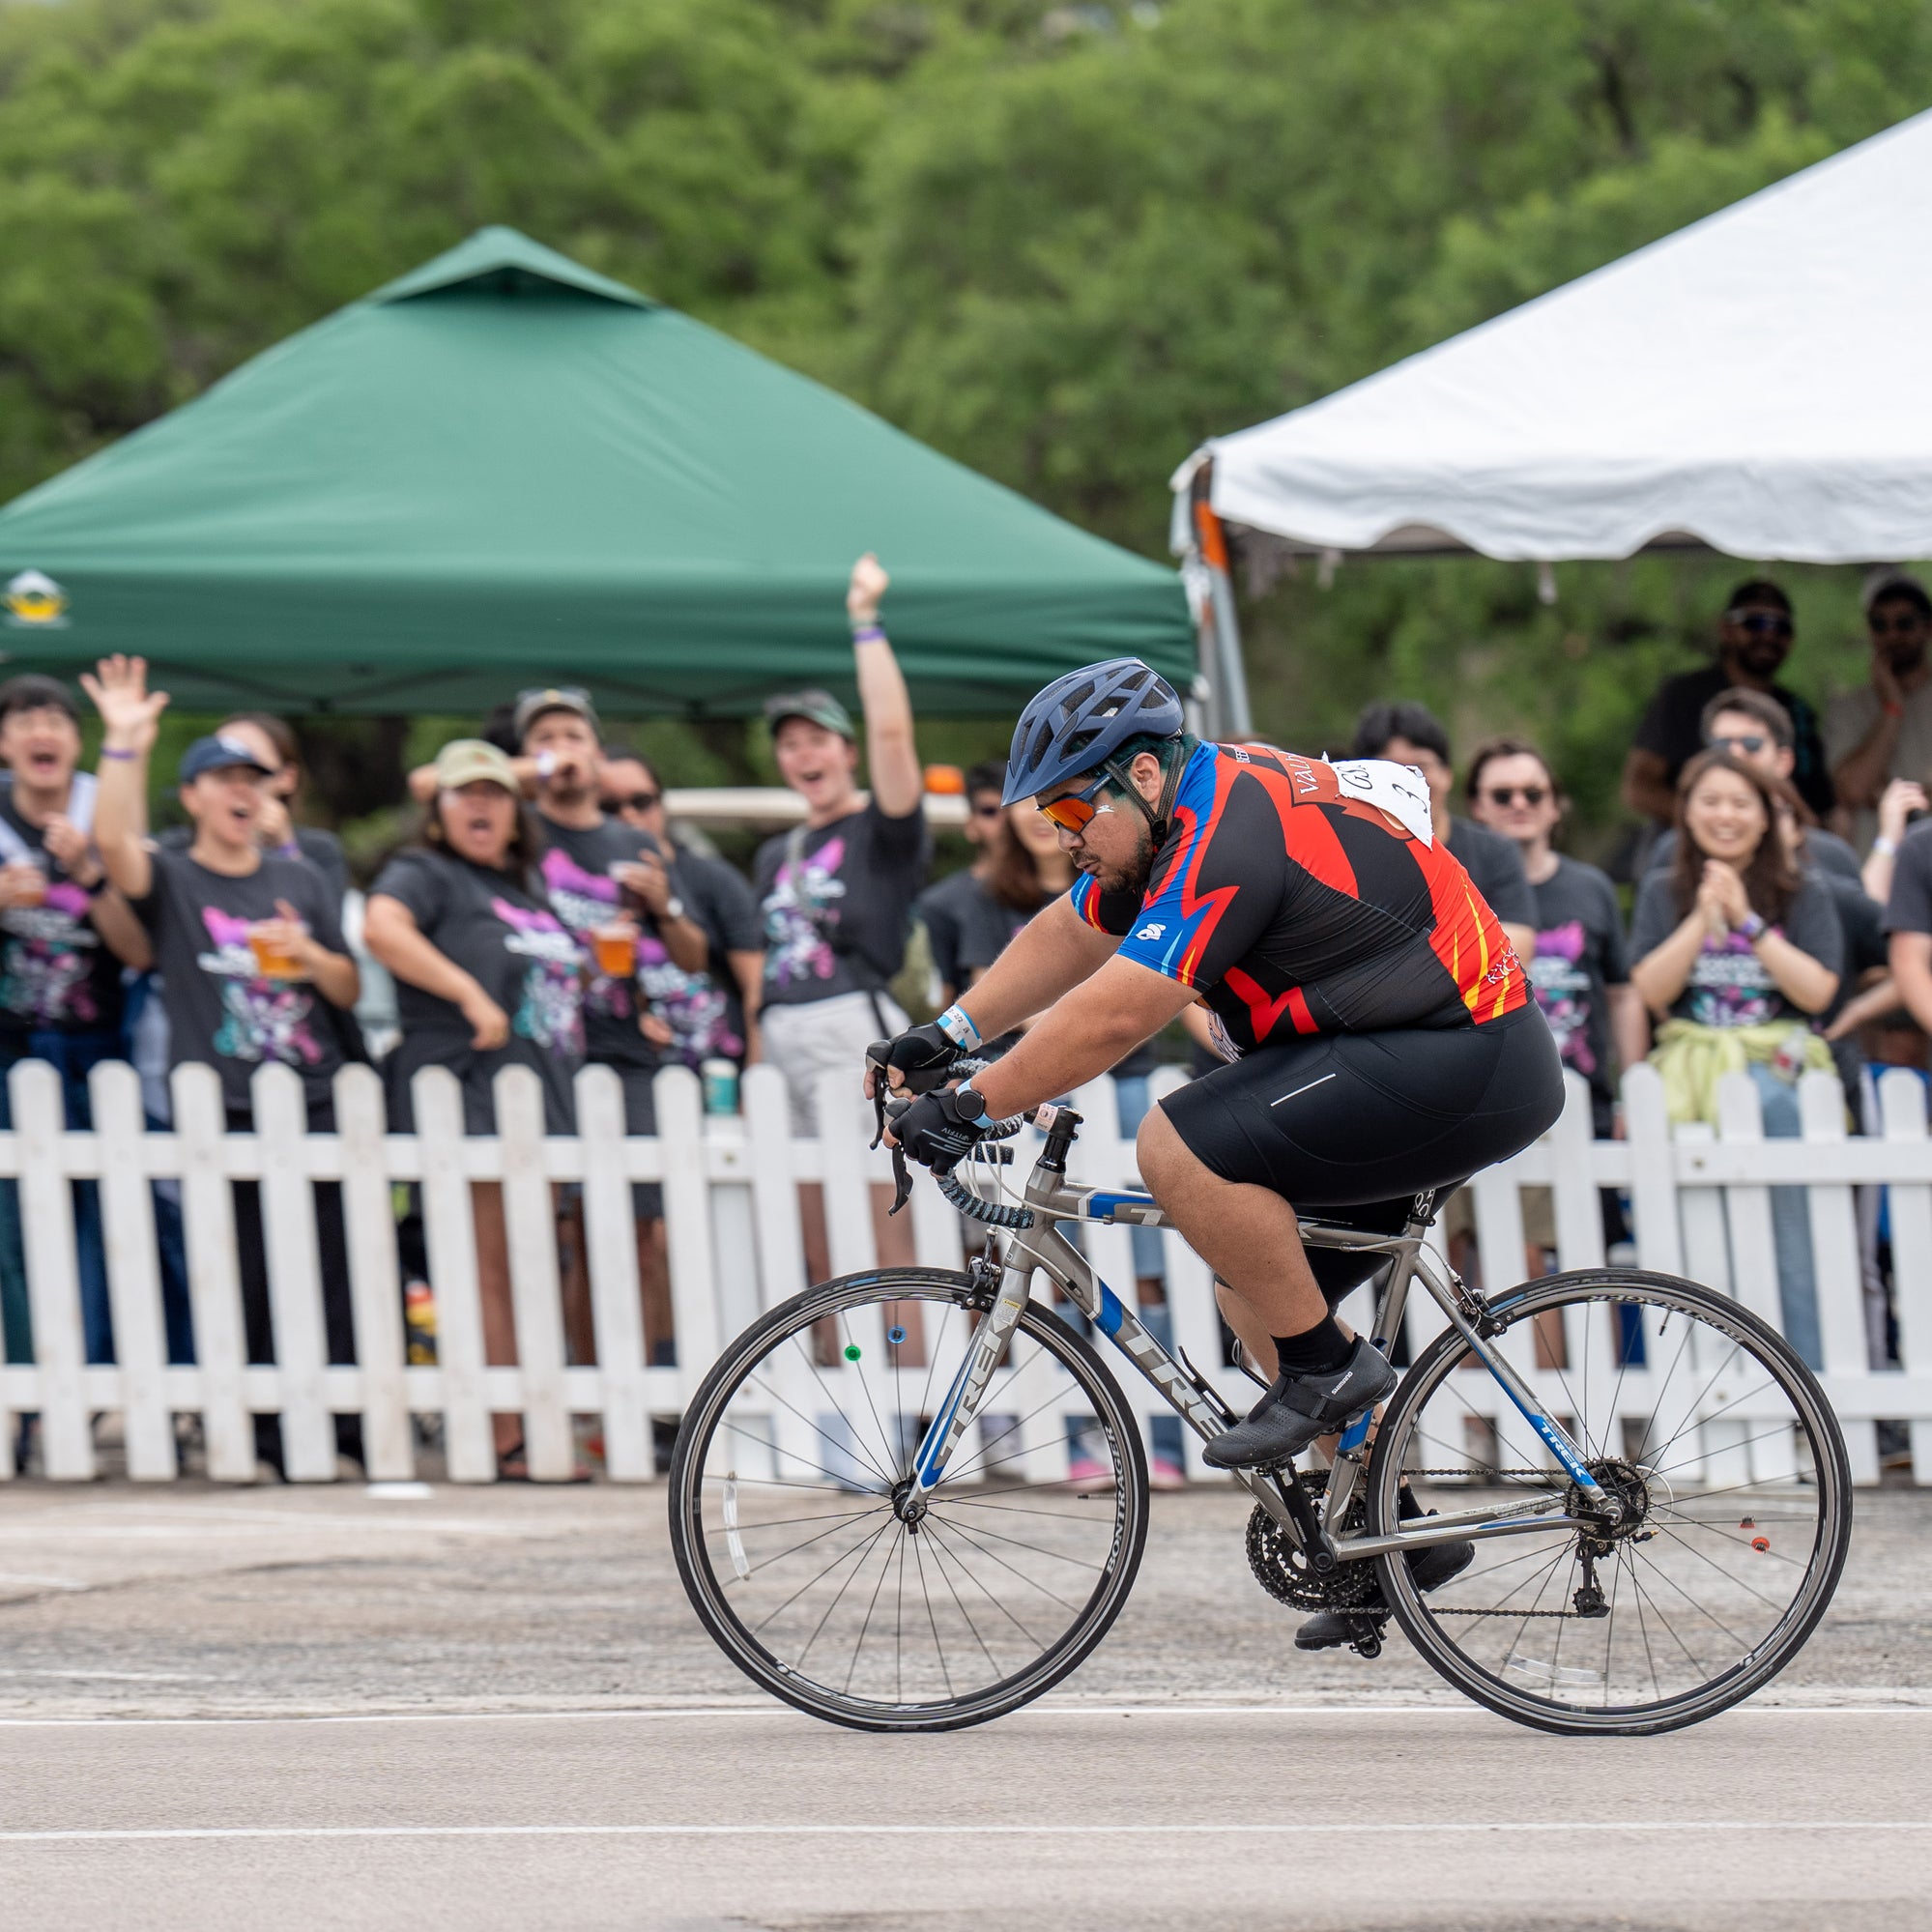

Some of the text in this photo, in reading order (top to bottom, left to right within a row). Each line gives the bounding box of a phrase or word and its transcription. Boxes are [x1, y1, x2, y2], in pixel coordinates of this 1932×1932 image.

[940, 1314, 1015, 1457] TREK
[1125, 1318, 1229, 1440] TRE
[1331, 1370, 1353, 1395] SHIMANO
[1105, 1425, 1126, 1576] BONTRAGER
[1541, 1422, 1587, 1478] TREK
